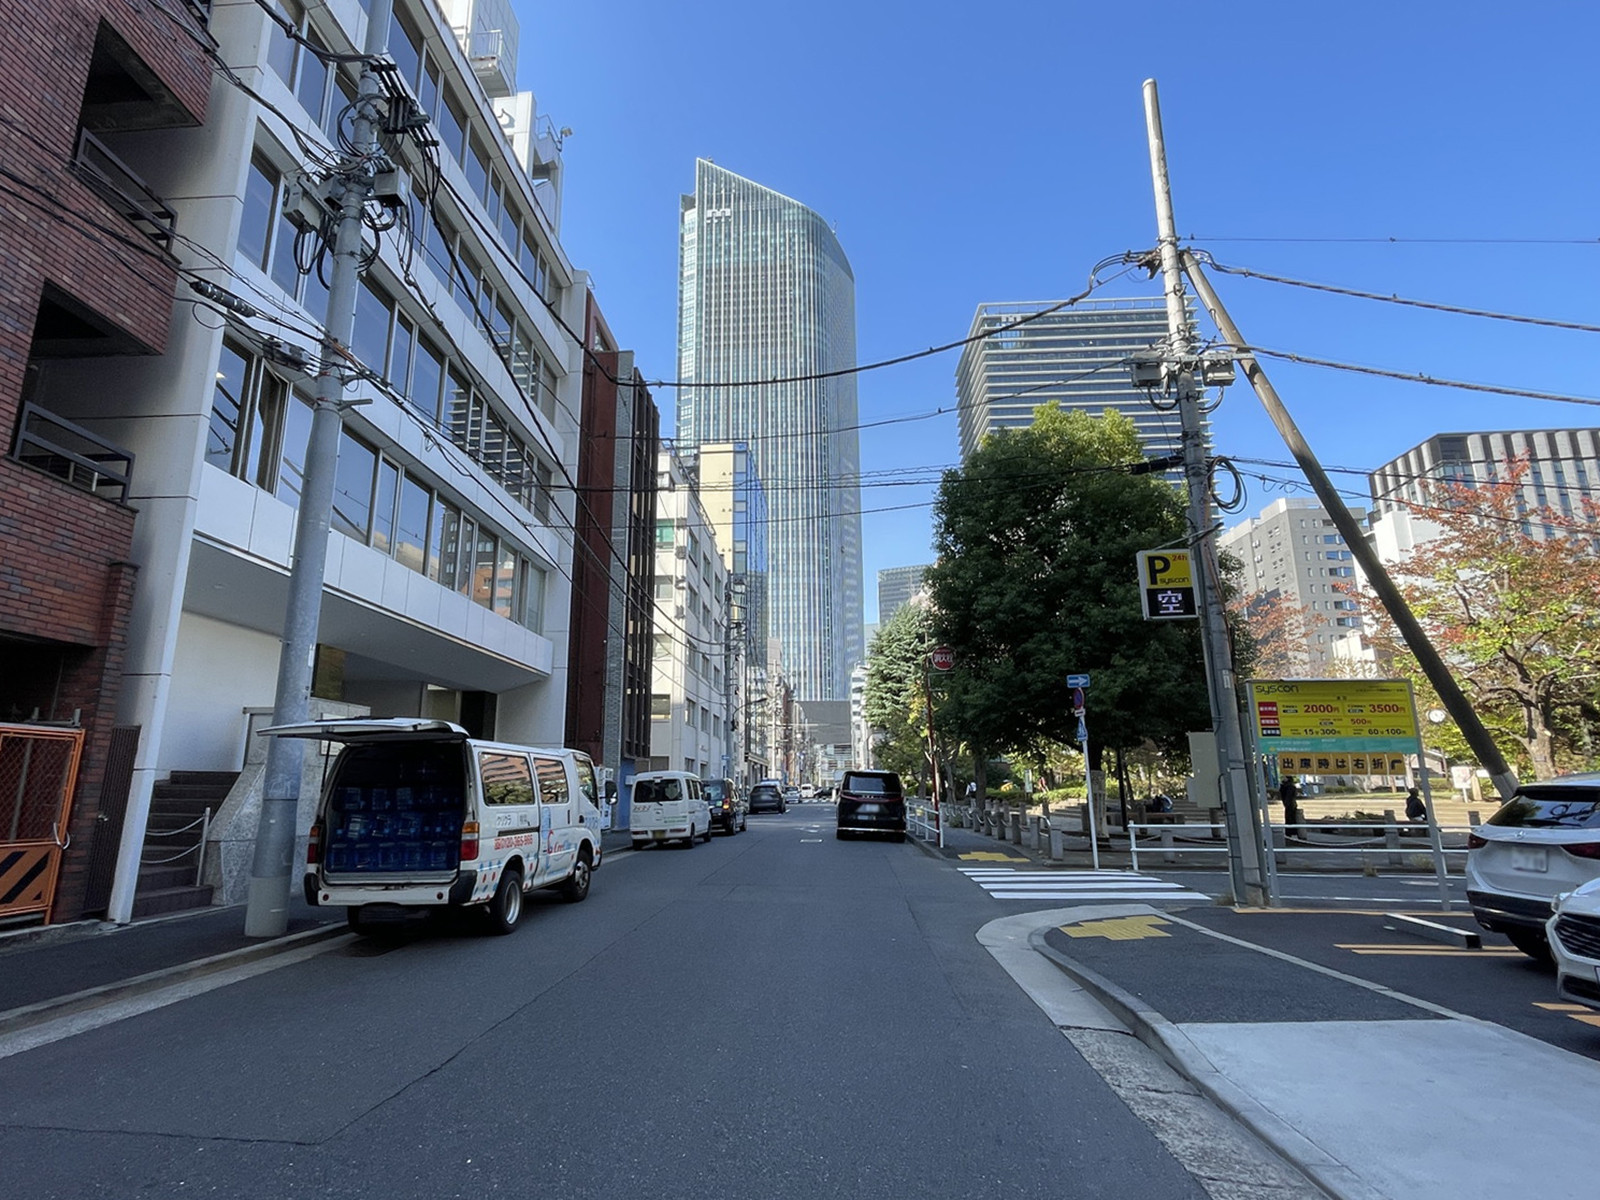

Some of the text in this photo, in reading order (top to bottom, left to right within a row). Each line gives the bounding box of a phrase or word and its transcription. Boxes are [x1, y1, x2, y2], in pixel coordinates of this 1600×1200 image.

[1147, 556, 1171, 585] P
[1157, 590, 1184, 614] 空
[1255, 685, 1299, 695] syscon
